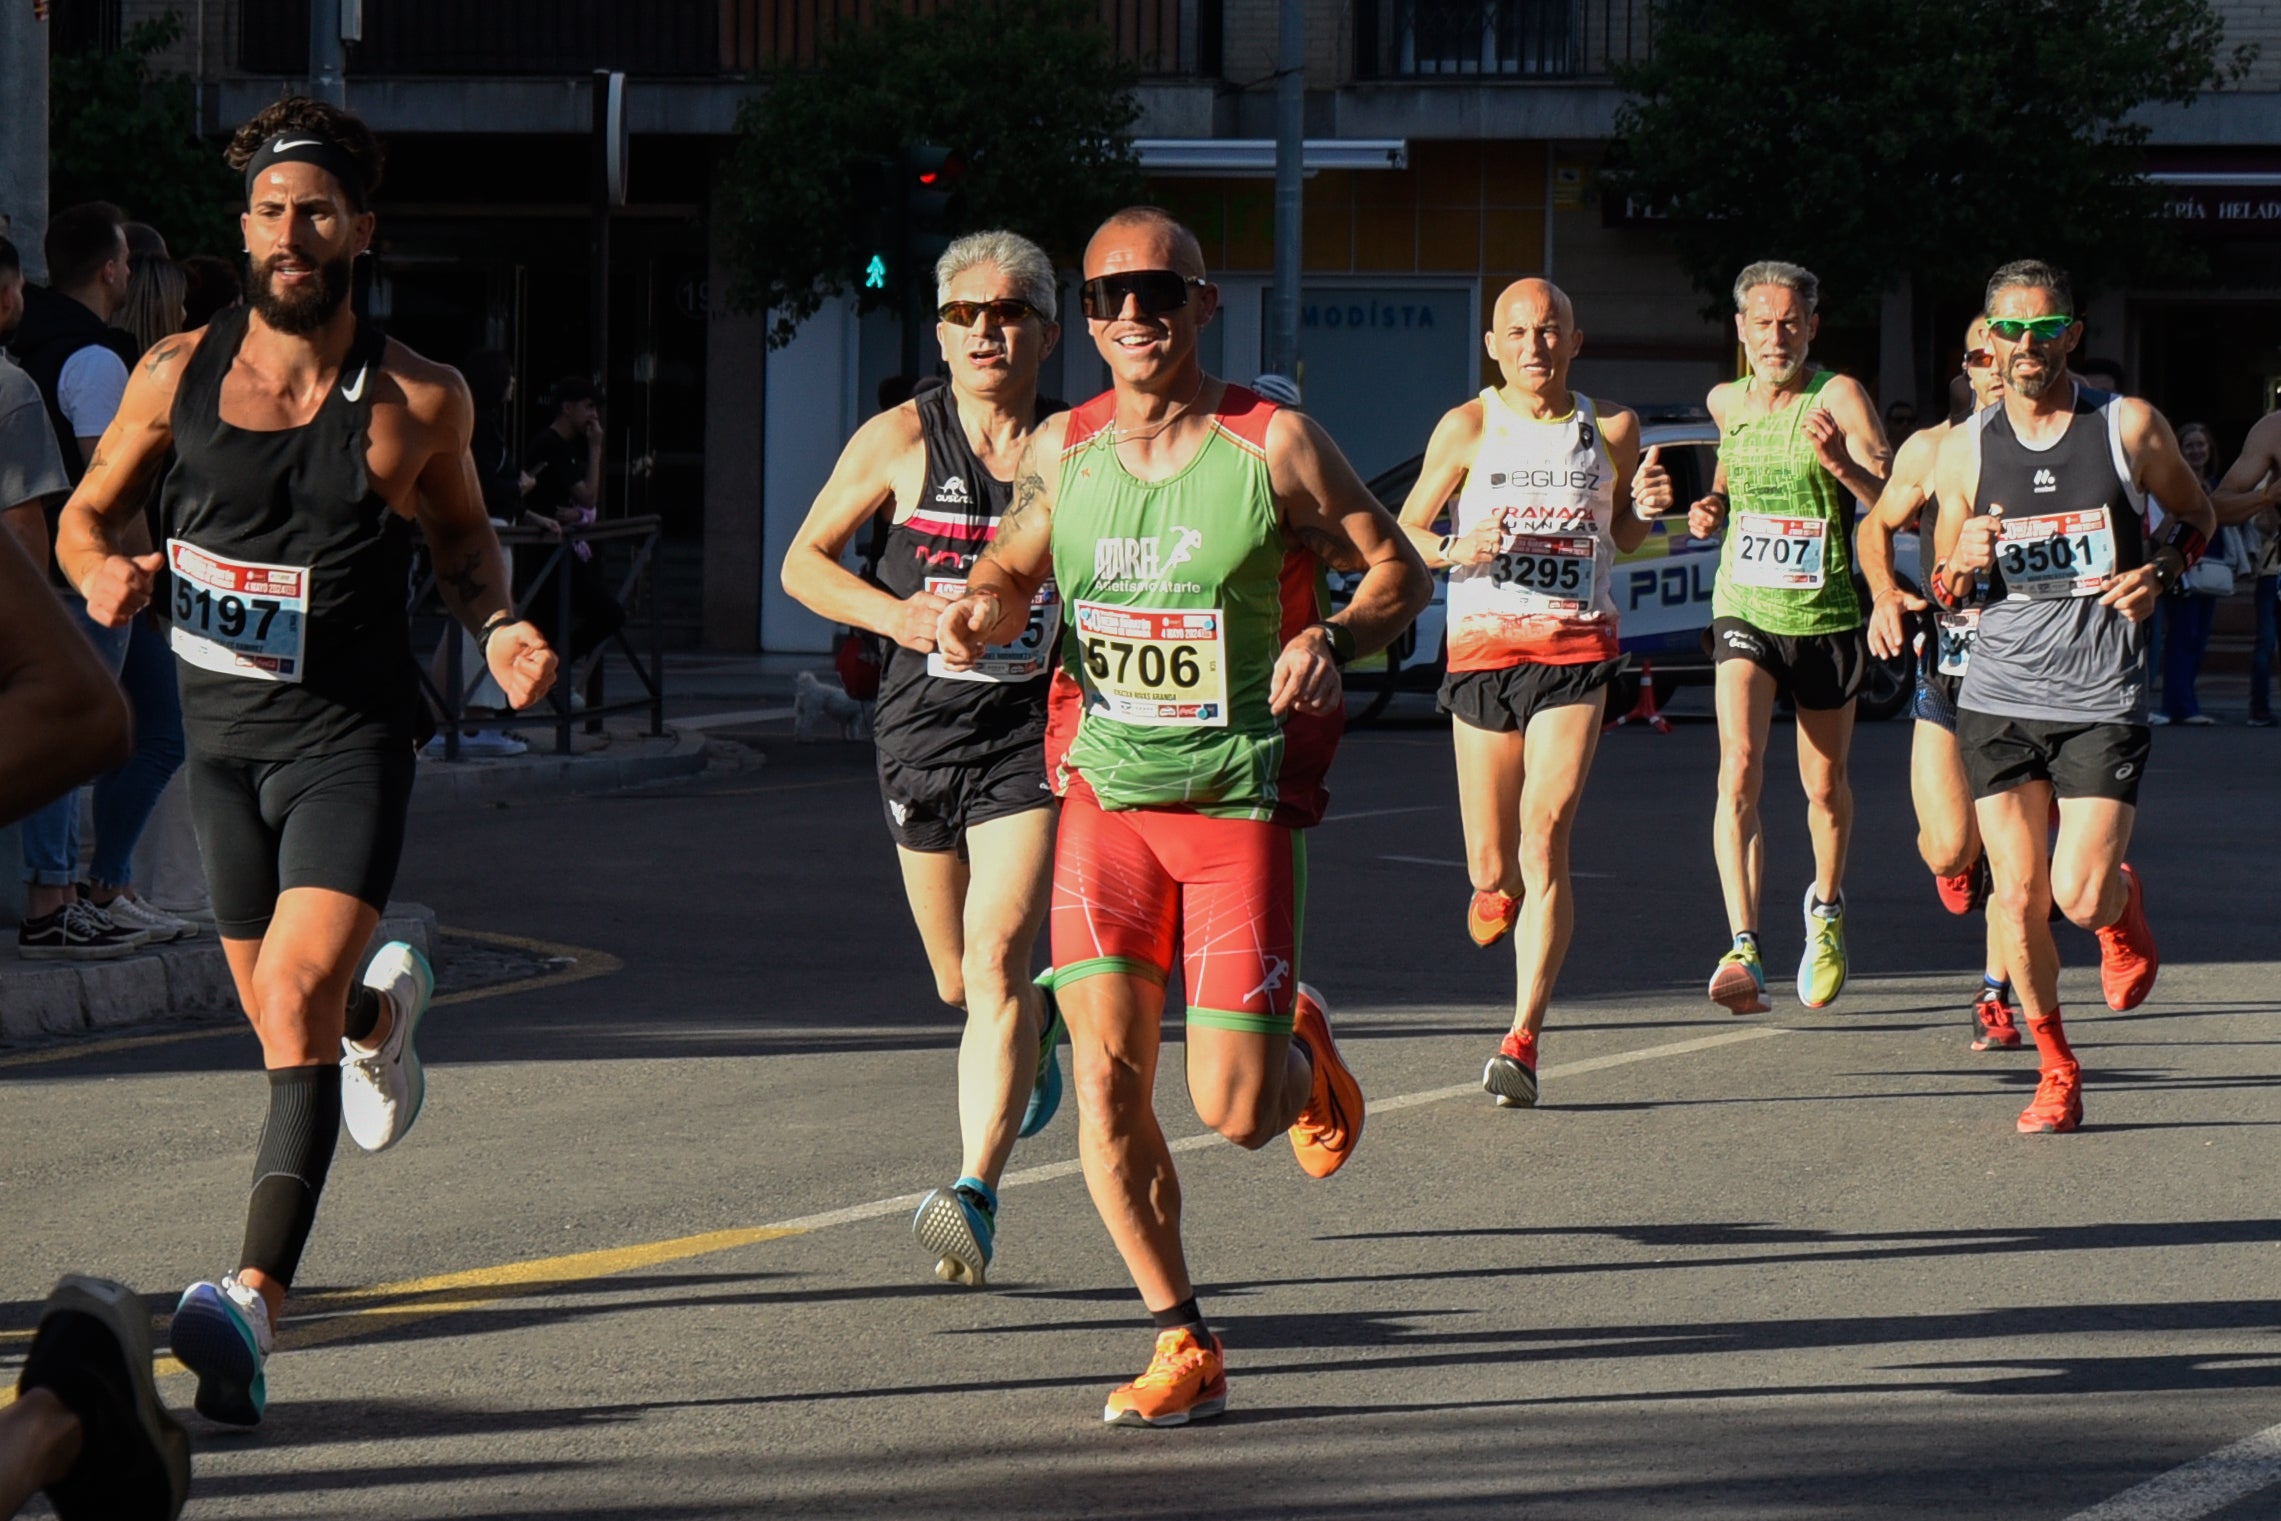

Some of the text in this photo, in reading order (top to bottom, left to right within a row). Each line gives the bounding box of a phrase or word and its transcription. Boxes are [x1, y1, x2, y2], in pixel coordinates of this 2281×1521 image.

[2219, 202, 2281, 219] HELAD
[1302, 300, 1435, 327] MODÍSTA
[1504, 520, 1599, 532] UNNERS
[1741, 535, 1811, 565] 2707
[2003, 534, 2092, 575] 3501
[1160, 580, 1201, 593] Atarfe
[1493, 552, 1580, 590] 3295
[1629, 563, 1714, 611] POL
[175, 573, 281, 641] 5197
[1086, 637, 1200, 688] 5706
